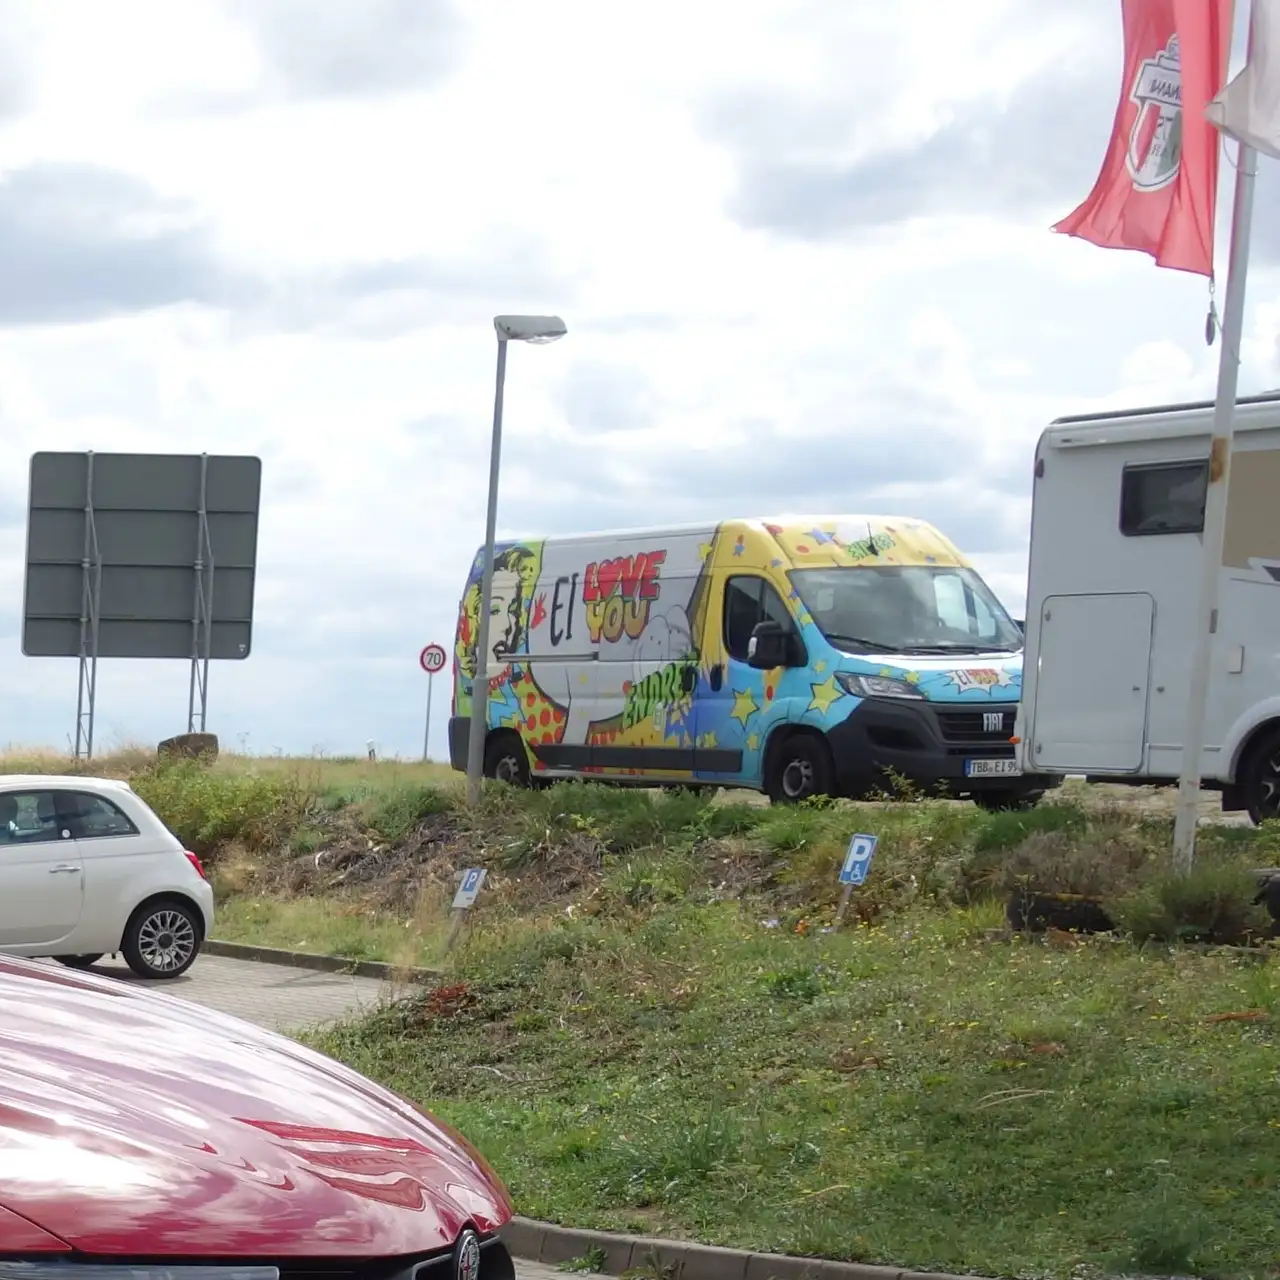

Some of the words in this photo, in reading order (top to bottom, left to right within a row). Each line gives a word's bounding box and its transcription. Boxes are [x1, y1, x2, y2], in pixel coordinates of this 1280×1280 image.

[585, 597, 651, 644] YOU
[426, 652, 442, 666] 70
[983, 713, 1004, 732] FIAT
[972, 761, 989, 773] TBB
[994, 761, 1005, 773] EI
[844, 838, 872, 873] P
[465, 872, 478, 889] P
